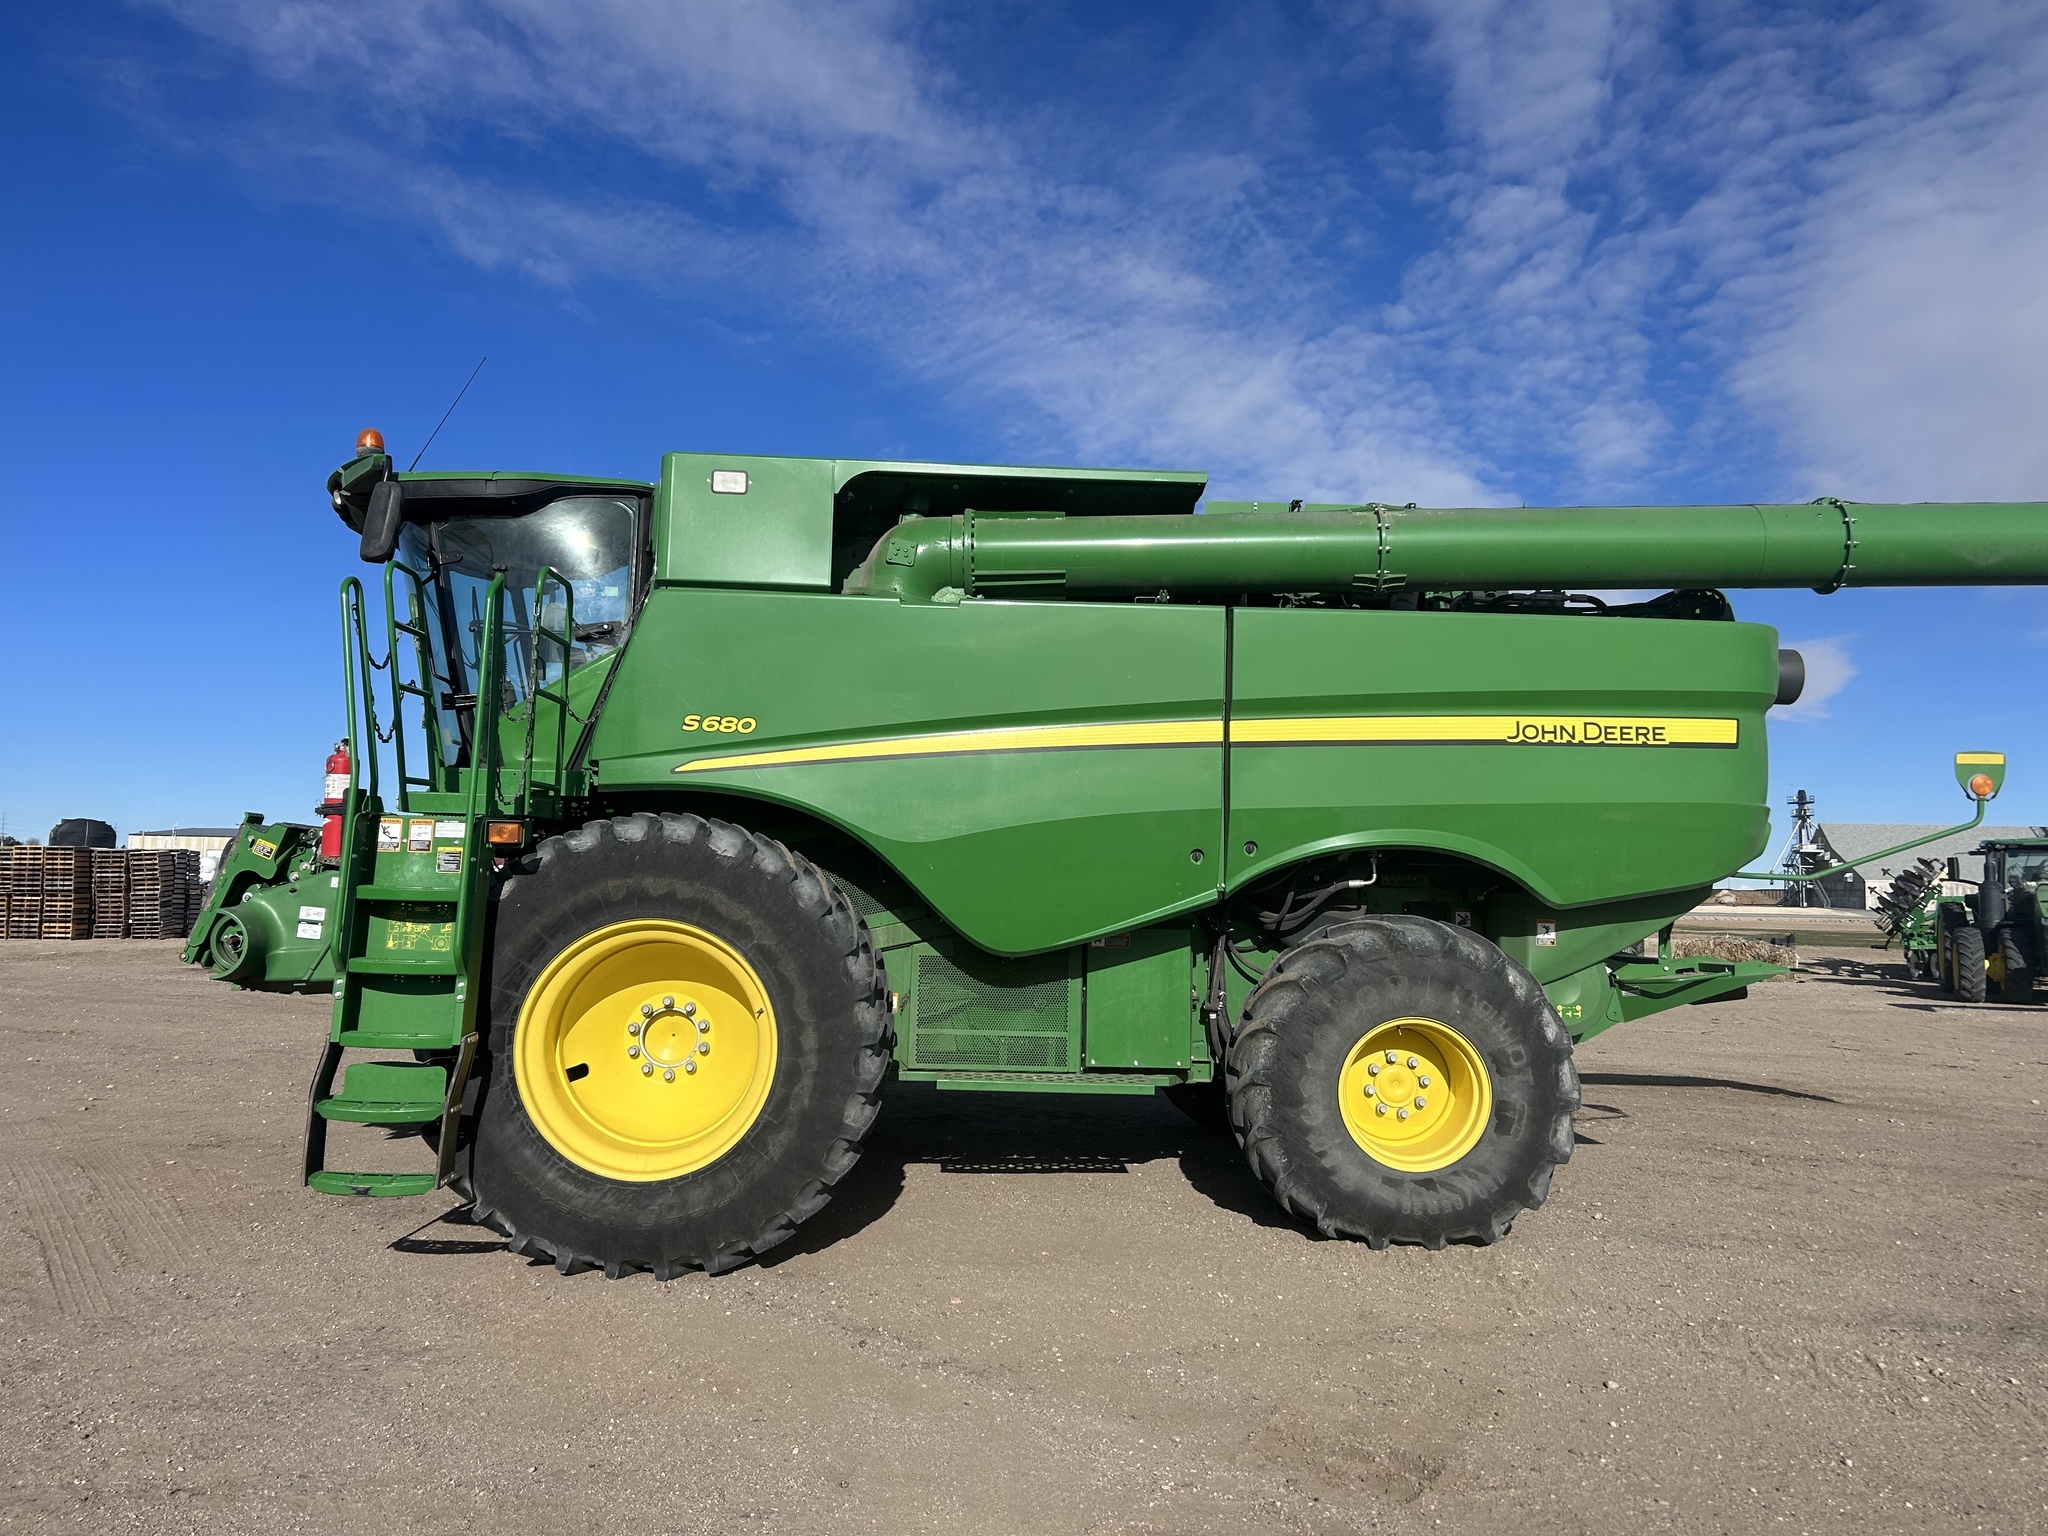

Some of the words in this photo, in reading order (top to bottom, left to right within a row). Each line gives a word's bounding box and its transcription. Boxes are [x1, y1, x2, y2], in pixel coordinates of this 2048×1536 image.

[681, 713, 758, 735] S680
[1506, 720, 1576, 741] JOHN
[1583, 721, 1666, 742] DEERE
